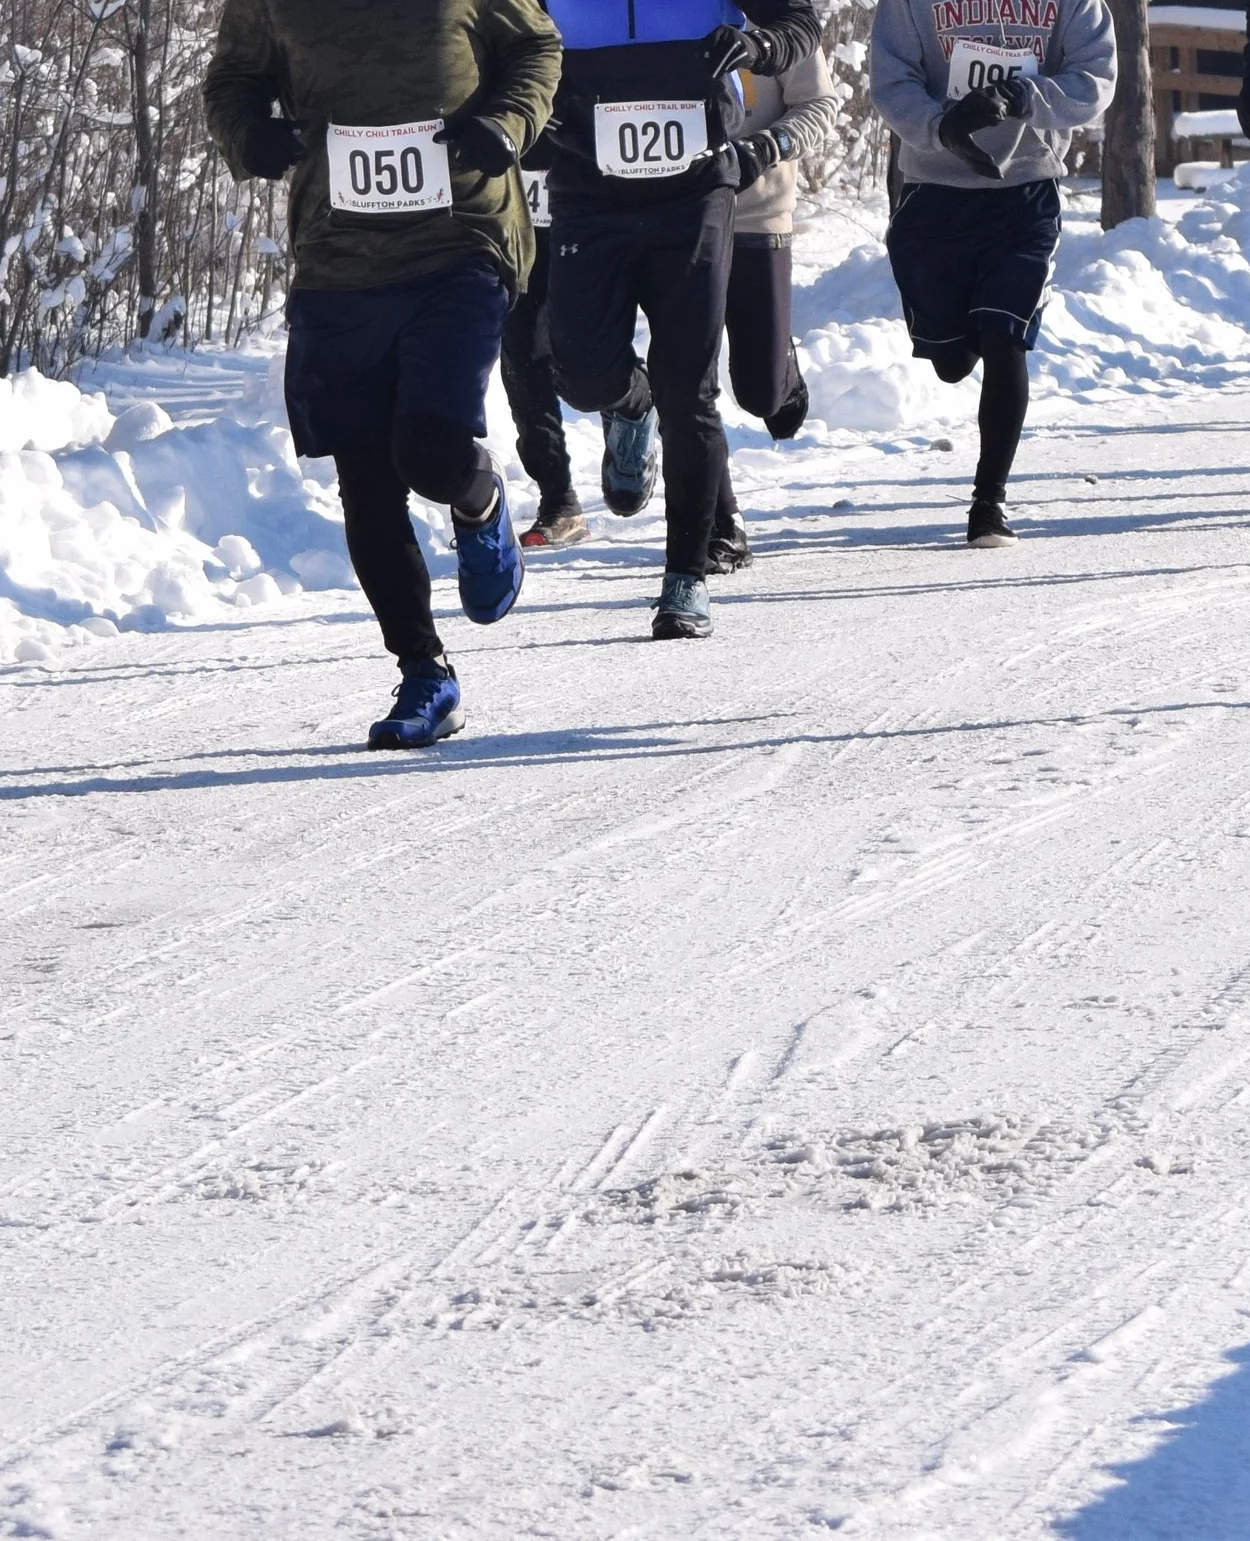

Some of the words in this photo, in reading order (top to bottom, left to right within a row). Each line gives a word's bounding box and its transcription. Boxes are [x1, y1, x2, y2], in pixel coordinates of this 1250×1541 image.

[963, 42, 986, 53] CHILLY
[986, 47, 1004, 57] CHILI
[605, 105, 633, 113] CHILLY
[634, 104, 655, 112] CHILI
[657, 103, 678, 111] TRAIL
[334, 128, 363, 138] CHILLY
[366, 129, 389, 138] CHILI
[391, 127, 416, 137] TRAIL
[418, 123, 438, 132] RUN
[618, 120, 685, 164] 020
[349, 146, 424, 196] 050
[621, 166, 660, 175] BLUFFTON
[351, 200, 395, 209] BLUFFTON
[396, 198, 425, 208] PARKS
